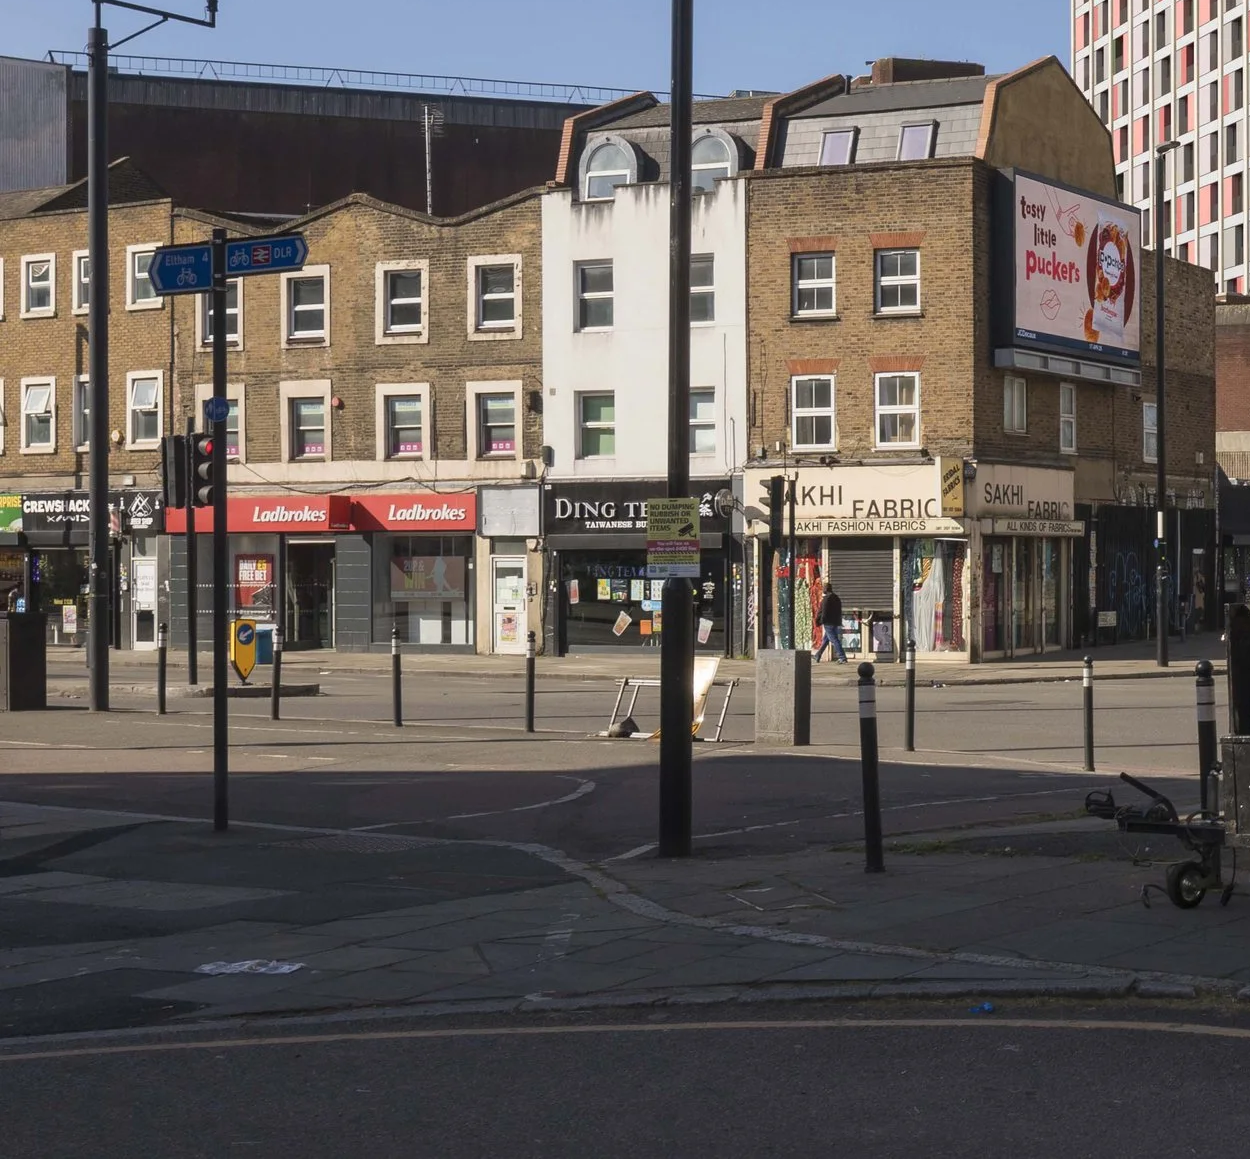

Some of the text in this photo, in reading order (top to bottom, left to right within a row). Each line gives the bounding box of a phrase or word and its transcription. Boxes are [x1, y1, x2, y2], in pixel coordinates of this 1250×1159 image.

[1020, 196, 1046, 221] tasty
[1034, 224, 1057, 248] little
[166, 252, 208, 266] Eltham 4
[274, 246, 292, 259] DLR
[1026, 250, 1080, 284] puckers
[942, 476, 961, 498] FABRICS
[984, 482, 1023, 506] SAKHI
[253, 506, 326, 522] Ladbrokes
[388, 504, 466, 521] Ladbrokes
[555, 498, 616, 518] DING
[852, 498, 937, 518] FABRIC
[1028, 500, 1070, 520] FABRIC
[585, 520, 633, 529] TAIWANESE
[827, 521, 874, 531] FASHION
[879, 521, 926, 531] FABRICS
[1007, 522, 1018, 531] ALL
[1020, 522, 1037, 531] KINDS
[1039, 522, 1046, 531] OF
[1048, 522, 1070, 532] FABRICS
[239, 560, 267, 570] DAILY £5
[239, 570, 267, 581] FREE BET
